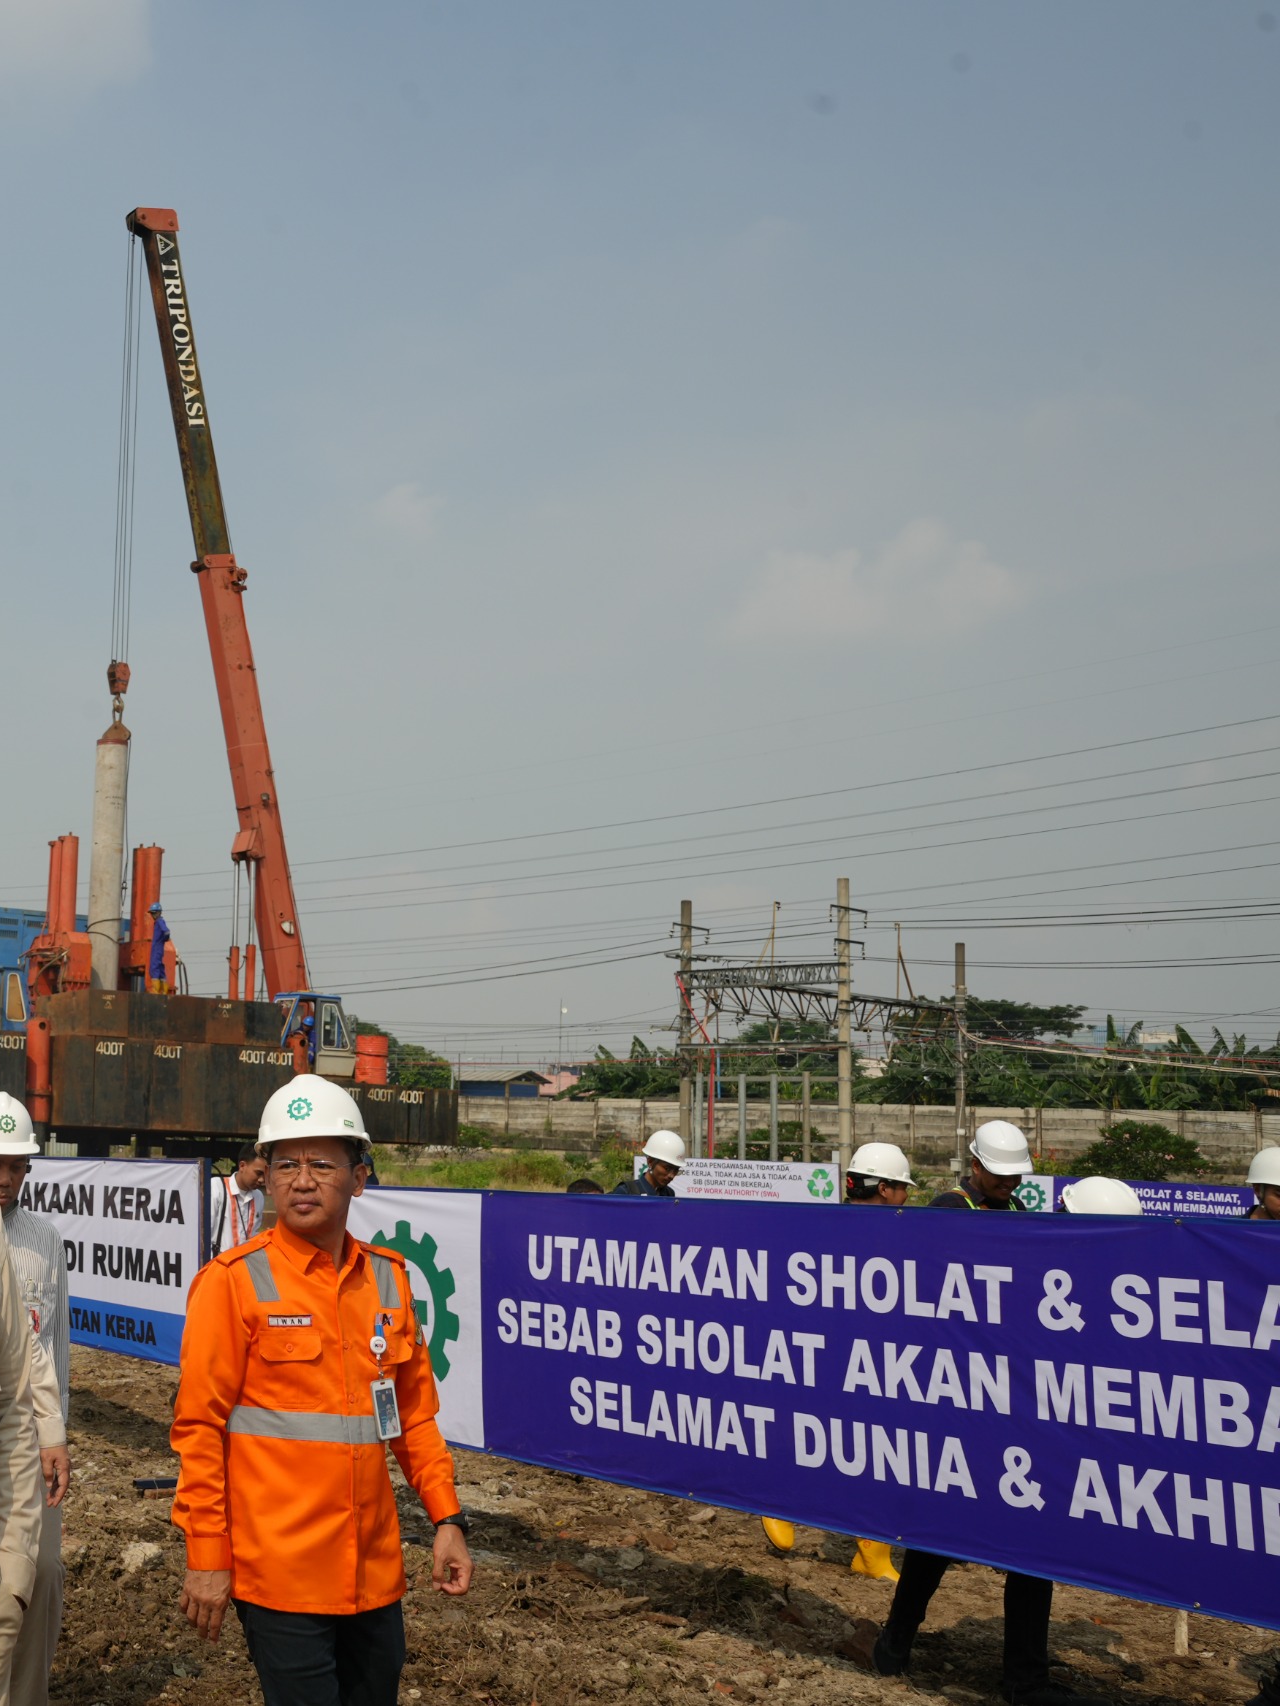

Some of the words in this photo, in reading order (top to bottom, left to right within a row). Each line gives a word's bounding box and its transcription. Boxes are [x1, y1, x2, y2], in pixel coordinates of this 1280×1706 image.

[161, 259, 206, 428] TRIPONDASI
[96, 1041, 125, 1056] 400T
[154, 1044, 182, 1059] 400T
[239, 1050, 266, 1065] 400T
[266, 1051, 294, 1066] 400T
[368, 1088, 393, 1102] 400T
[399, 1090, 425, 1104] 400T
[741, 1181, 773, 1189] BEKERJA)
[724, 1189, 760, 1197] AUTHORITY
[760, 1190, 780, 1199] (SWA)
[1174, 1189, 1183, 1200] &
[1186, 1190, 1241, 1205] SELAMAT,
[19, 1181, 95, 1217] AKAAN
[102, 1185, 185, 1225] KERJA
[63, 1239, 84, 1273] DI
[92, 1242, 182, 1288] RUMAH
[528, 1234, 768, 1302] UTAMAKAN
[786, 1251, 1013, 1325] SHOLAT
[1037, 1268, 1086, 1333] &
[105, 1313, 157, 1346] KERJA
[497, 1298, 623, 1359] SEBAB
[636, 1314, 825, 1388] SHOLAT
[843, 1338, 1011, 1416] AKAN
[569, 1376, 775, 1459] SELAMAT
[793, 1411, 978, 1500] DUNIA
[998, 1445, 1046, 1512] &
